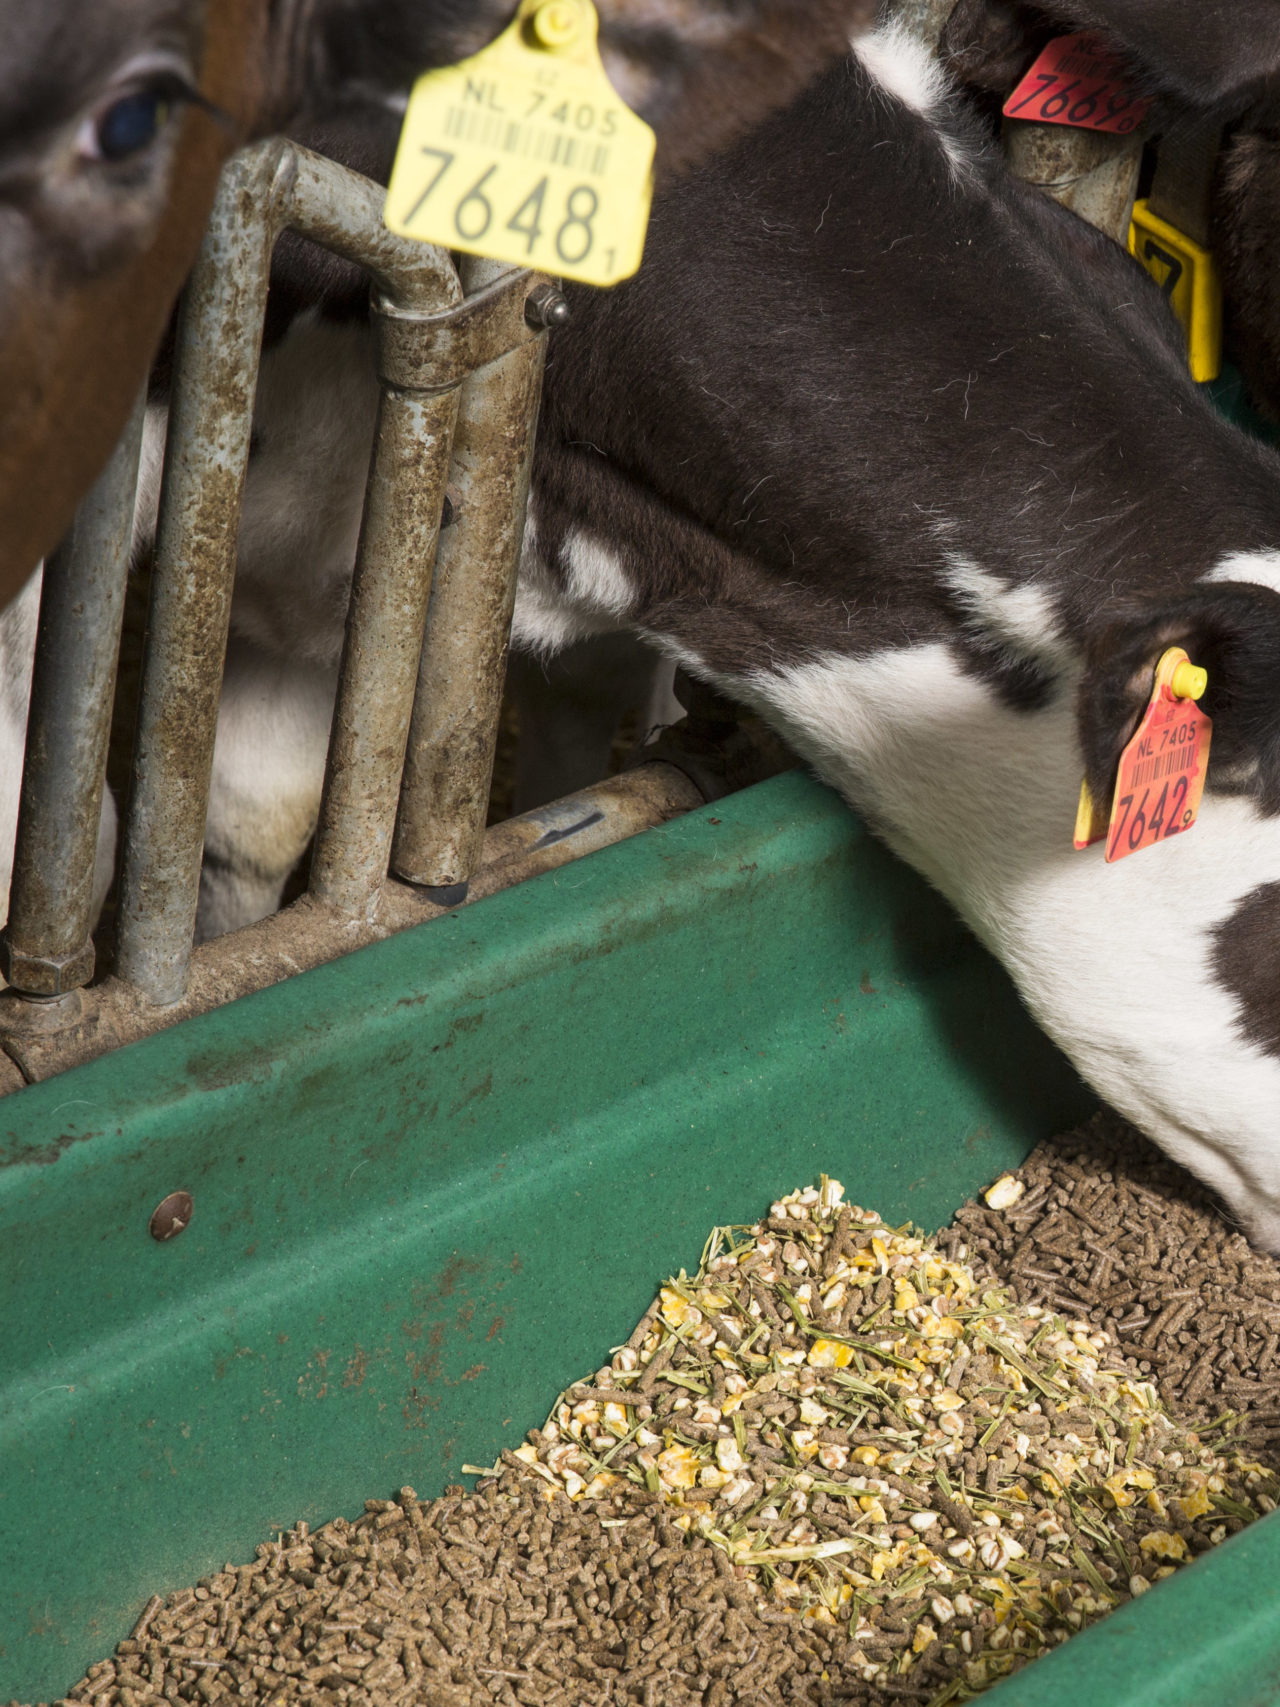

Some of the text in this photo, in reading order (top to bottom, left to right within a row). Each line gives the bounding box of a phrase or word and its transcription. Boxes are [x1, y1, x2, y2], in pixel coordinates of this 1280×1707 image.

[464, 76, 619, 137] NL 7405
[402, 145, 617, 273] 7648 1
[1137, 721, 1196, 761] NL 7405
[1109, 775, 1192, 860] 7642 9
